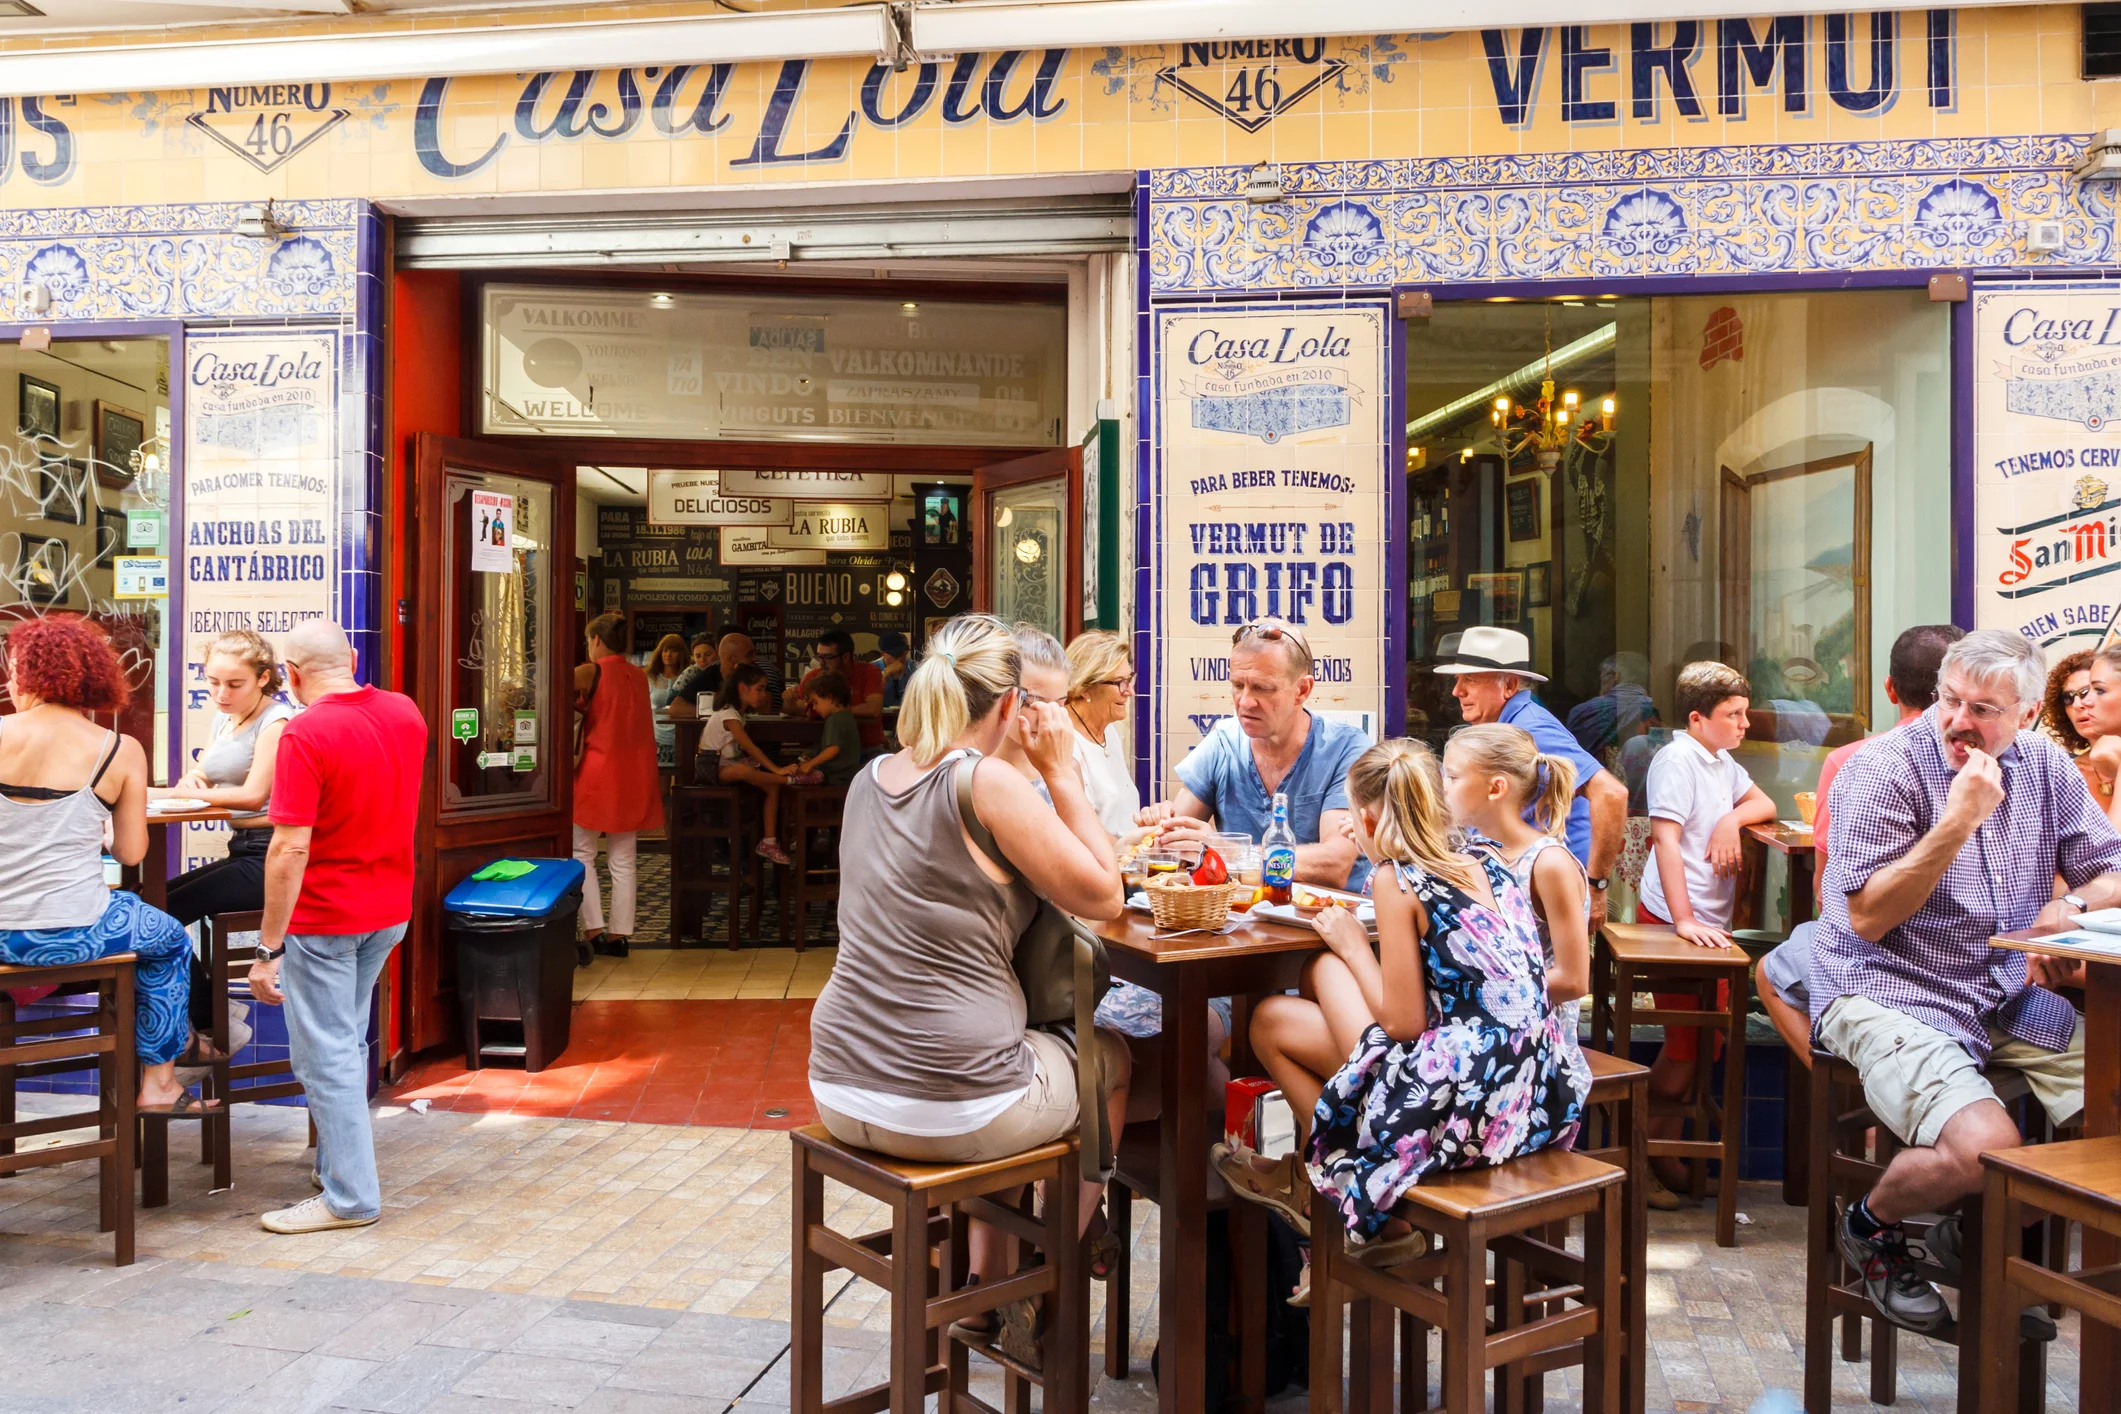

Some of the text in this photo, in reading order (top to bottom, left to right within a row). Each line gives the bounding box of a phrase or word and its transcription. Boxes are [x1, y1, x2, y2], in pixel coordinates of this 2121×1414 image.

[1225, 64, 1281, 111] 46
[0, 96, 76, 187] S
[245, 112, 292, 159] 46
[2004, 308, 2094, 346] Casa
[1188, 326, 1350, 365] Casa Lola
[192, 351, 322, 387] Casa Lola
[1205, 369, 1332, 394] casa fundada en 2010
[1224, 369, 1235, 378] 46
[287, 390, 312, 402] 2010
[524, 399, 649, 419] WELCOME
[1995, 449, 2075, 479] TENEMOS
[191, 472, 327, 496] PARA COMER TENEMOS:
[671, 480, 699, 489] PRUEBE
[1190, 470, 1355, 497] PARA BEBER TENEMOS:
[674, 499, 772, 514] DELICIOSOS
[189, 519, 326, 546] ANCHOAS DEL
[635, 525, 686, 536] 18.11.1986
[789, 517, 869, 535] LA RUBIA
[1189, 522, 1356, 556] VERMUT DE
[190, 551, 325, 582] CANTÁBRICO
[604, 549, 679, 567] LA RUBIA
[686, 547, 712, 560] LOLA
[627, 593, 675, 601] NAPOLEÓN
[677, 593, 708, 602] COMIÓ
[786, 573, 852, 605] BUENO
[1189, 561, 1356, 626] GRIFO
[2019, 604, 2111, 640] BIEN SABE
[1268, 861, 1291, 869] NESTEA
